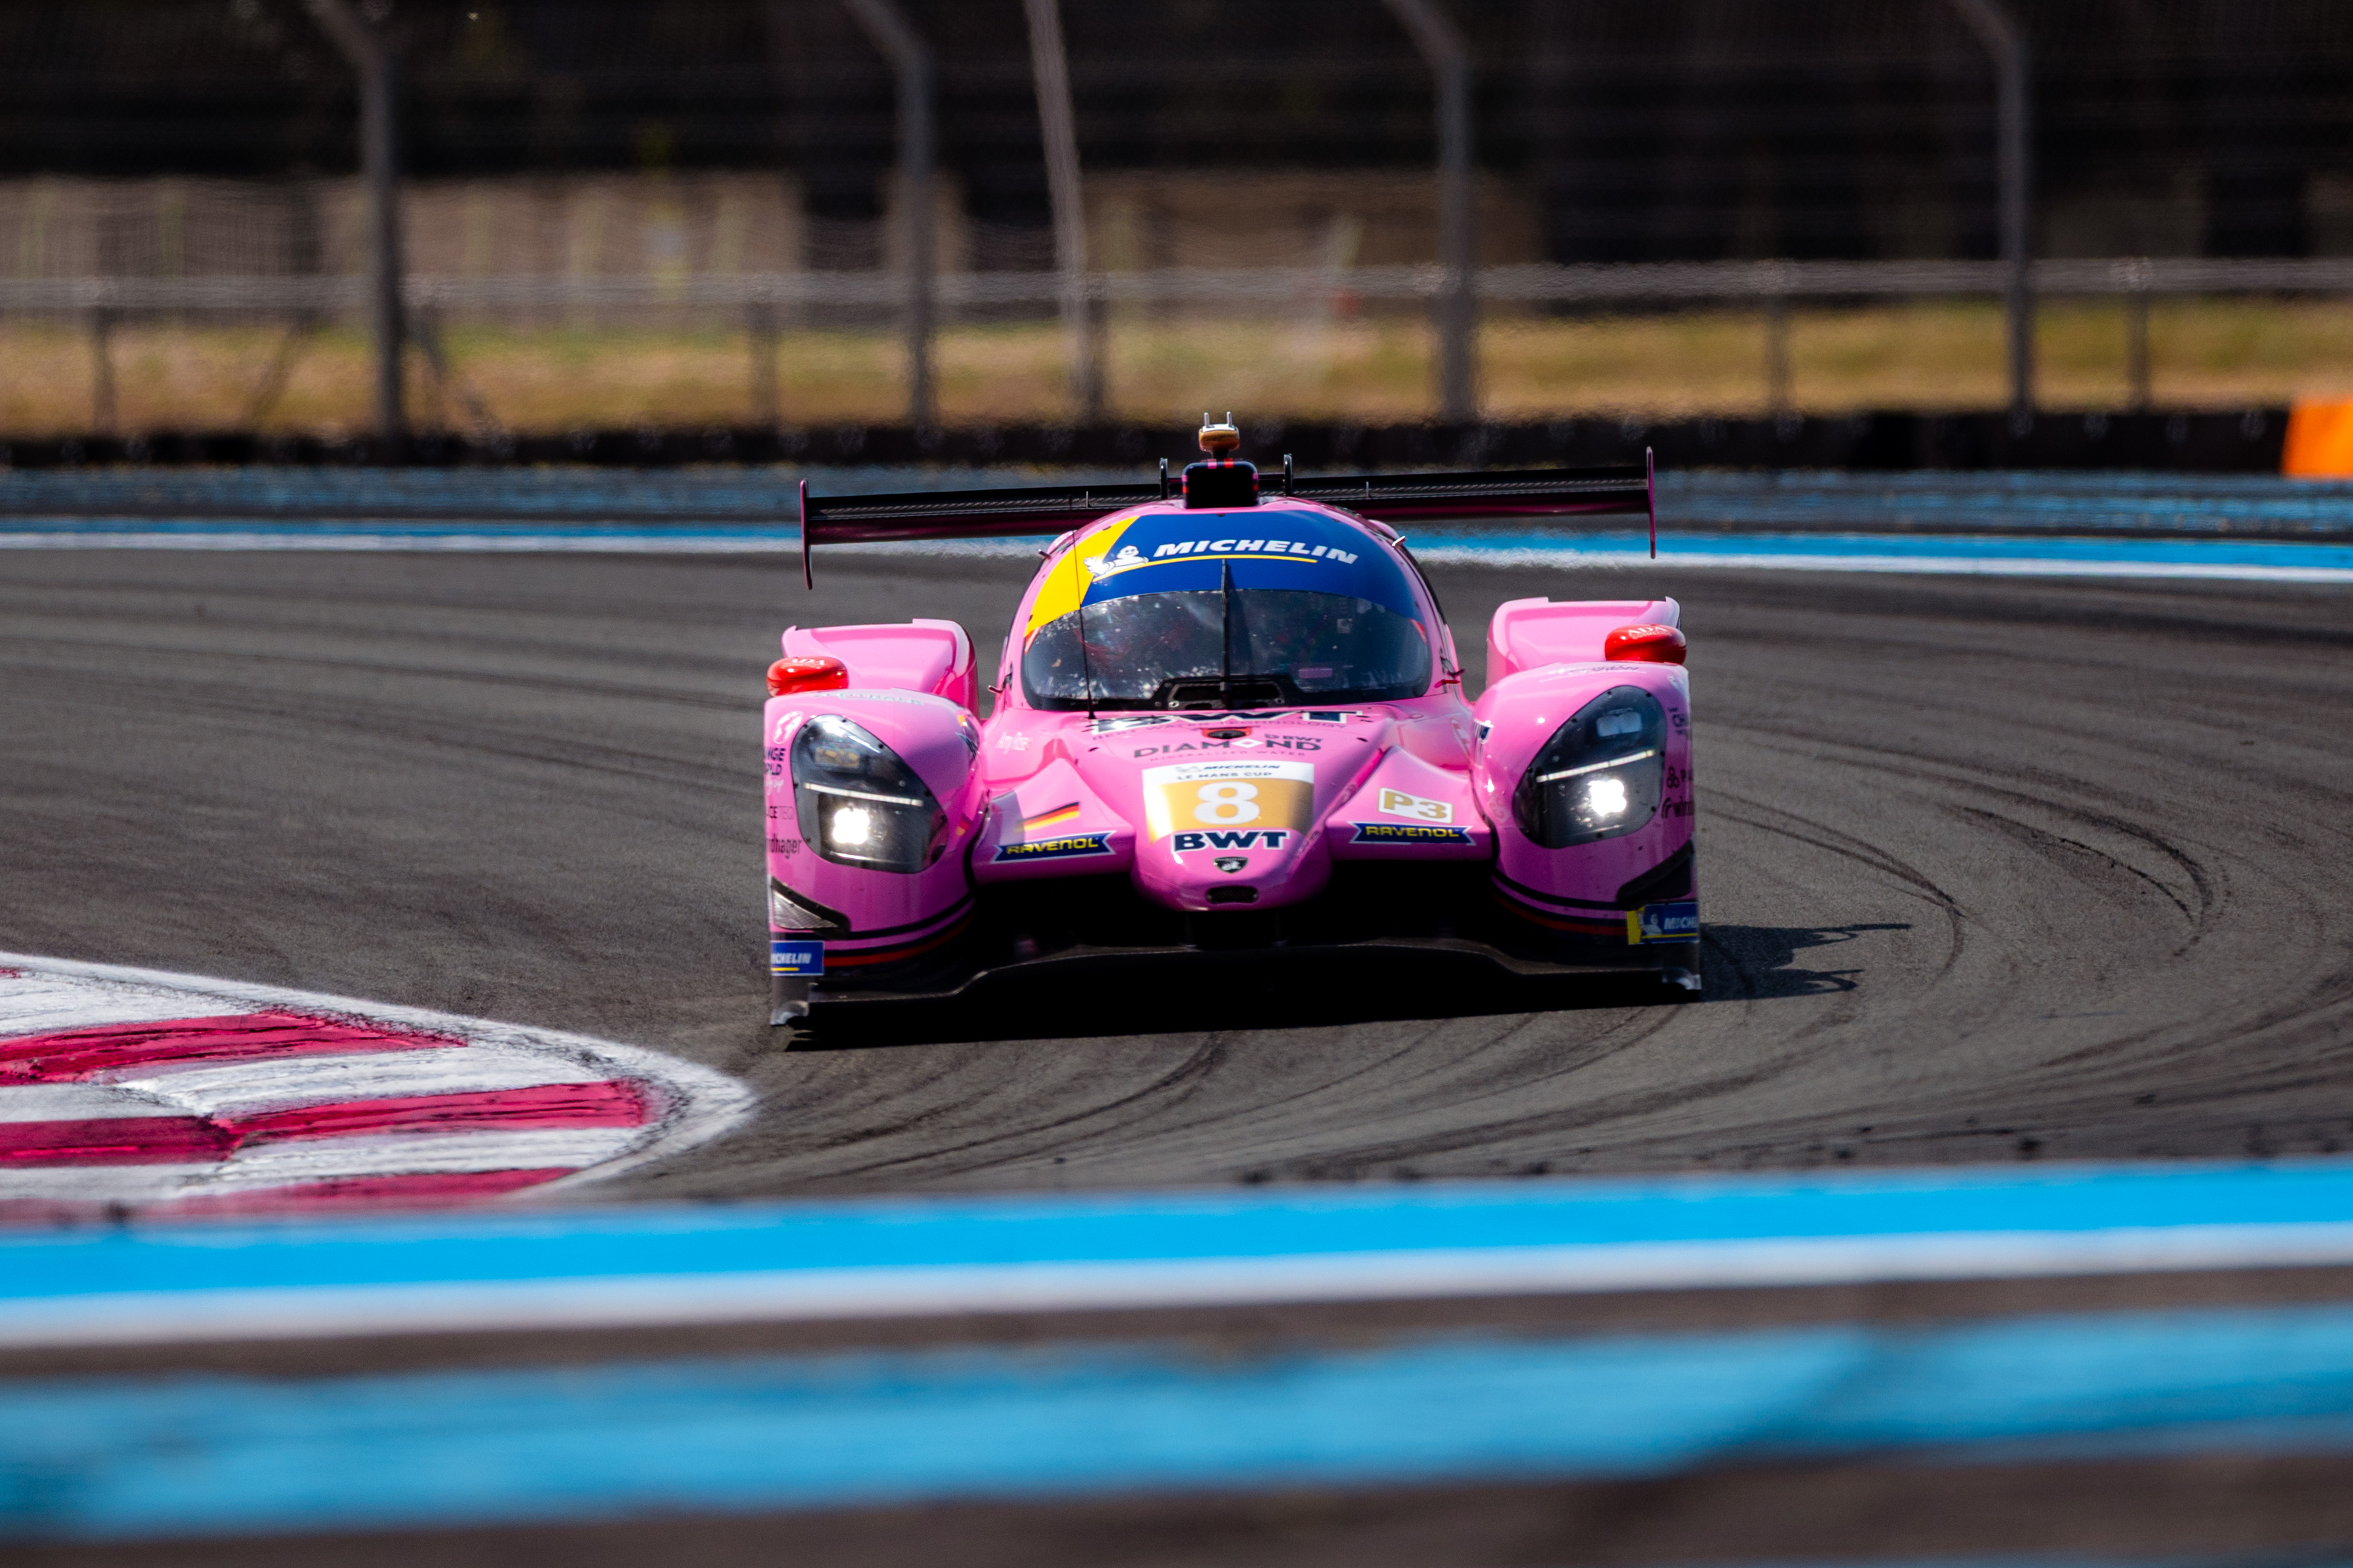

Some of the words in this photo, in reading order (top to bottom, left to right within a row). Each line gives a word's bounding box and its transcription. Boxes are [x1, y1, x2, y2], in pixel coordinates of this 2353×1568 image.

[1153, 538, 1359, 565] MICHELIN
[1091, 710, 1363, 735] BWT
[1193, 781, 1261, 824] 8
[1383, 790, 1447, 819] P3
[1172, 830, 1289, 852] BWT
[1365, 825, 1461, 838] RAVENOL
[1006, 837, 1100, 855] RAVENOL
